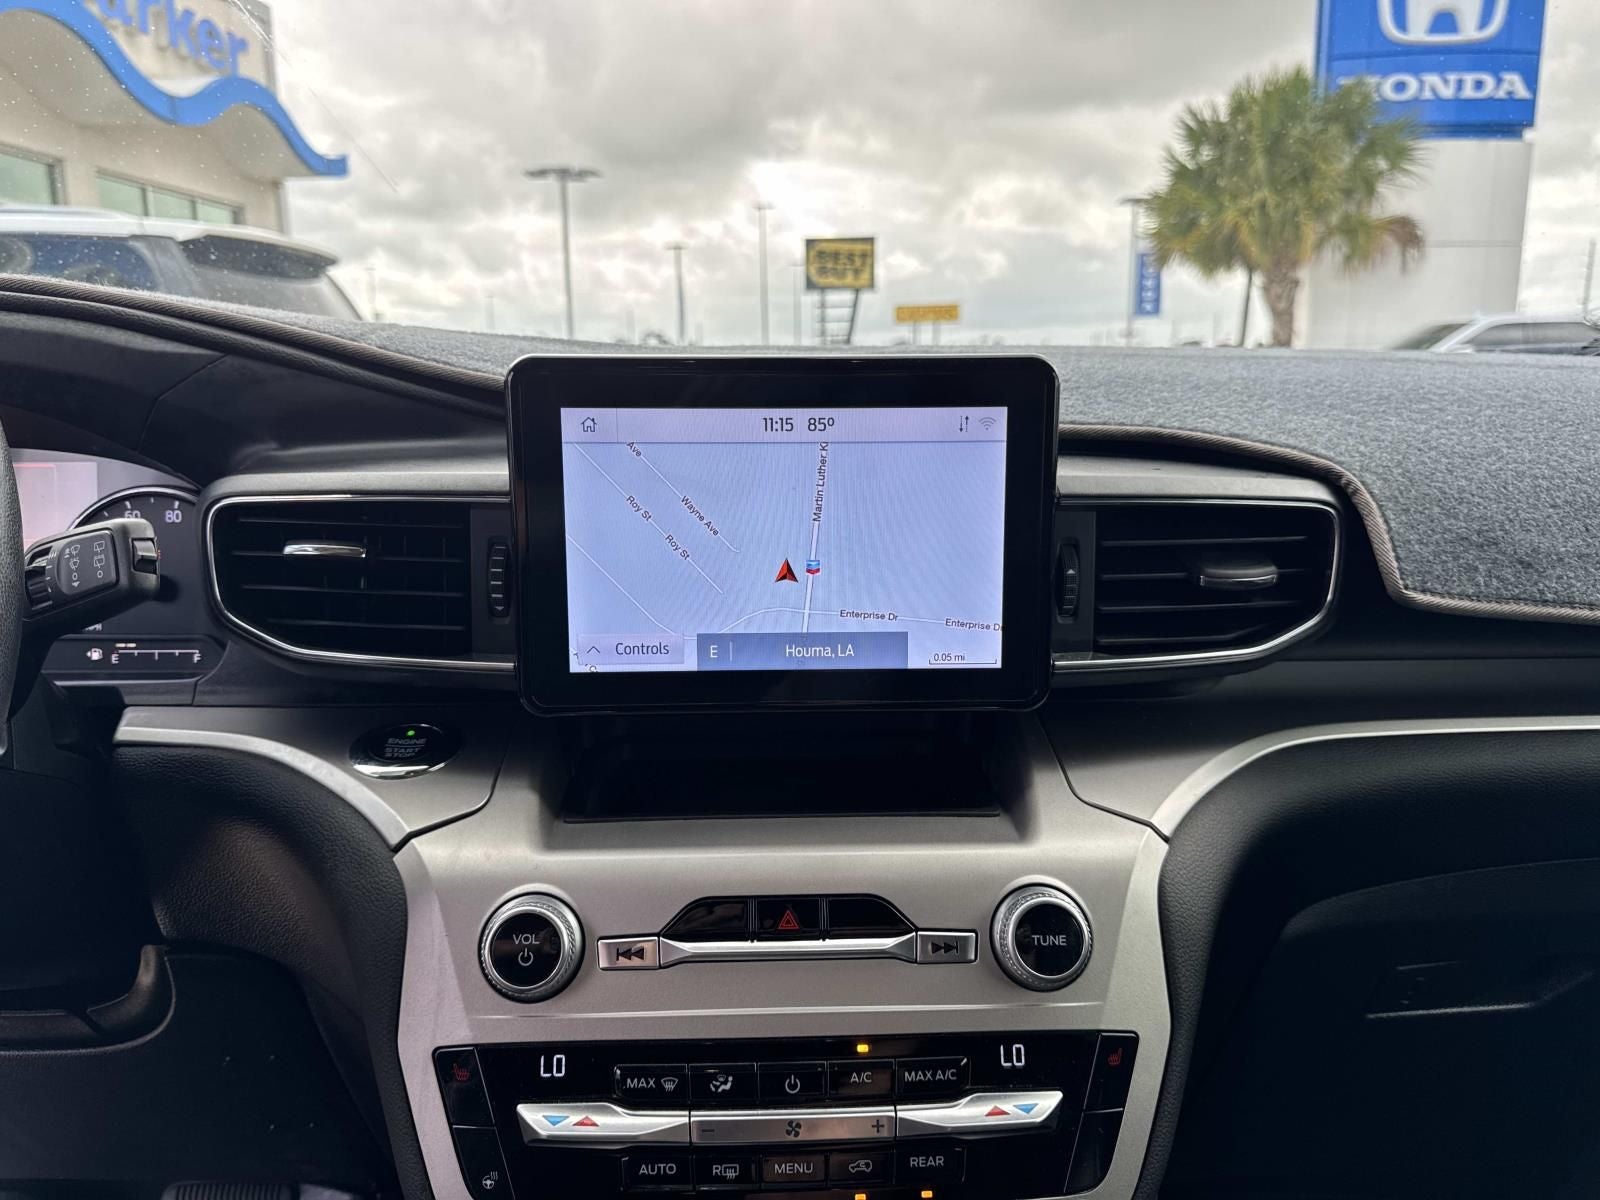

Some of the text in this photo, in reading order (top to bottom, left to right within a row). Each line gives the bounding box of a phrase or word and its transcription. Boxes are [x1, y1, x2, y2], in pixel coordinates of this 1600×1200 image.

[1336, 72, 1532, 101] ONDA
[816, 250, 870, 267] BEST
[763, 417, 794, 432] 11:15
[626, 441, 642, 457] Ave
[816, 453, 828, 487] Luther
[626, 495, 652, 522] Roy St
[812, 489, 824, 522] Martin
[165, 511, 182, 523] 80
[681, 495, 719, 536] Wayne Ave
[665, 534, 690, 561] Roy St
[840, 609, 899, 622] Enterprise Dr
[945, 618, 991, 630] Enterprise
[615, 642, 670, 656] Controls
[709, 645, 719, 658] E
[785, 643, 855, 658] Houma, LA
[111, 653, 119, 664] E
[193, 652, 202, 664] F
[933, 653, 966, 662] 0.05 mi
[512, 932, 540, 946] VOL
[1031, 933, 1068, 948] TUNE
[850, 1072, 873, 1084] A/C
[904, 1069, 957, 1082] MAX A/C
[626, 1078, 656, 1089] MAX
[910, 1156, 945, 1168] REAR
[639, 1163, 677, 1176] AUTO
[774, 1163, 813, 1175] MENU
